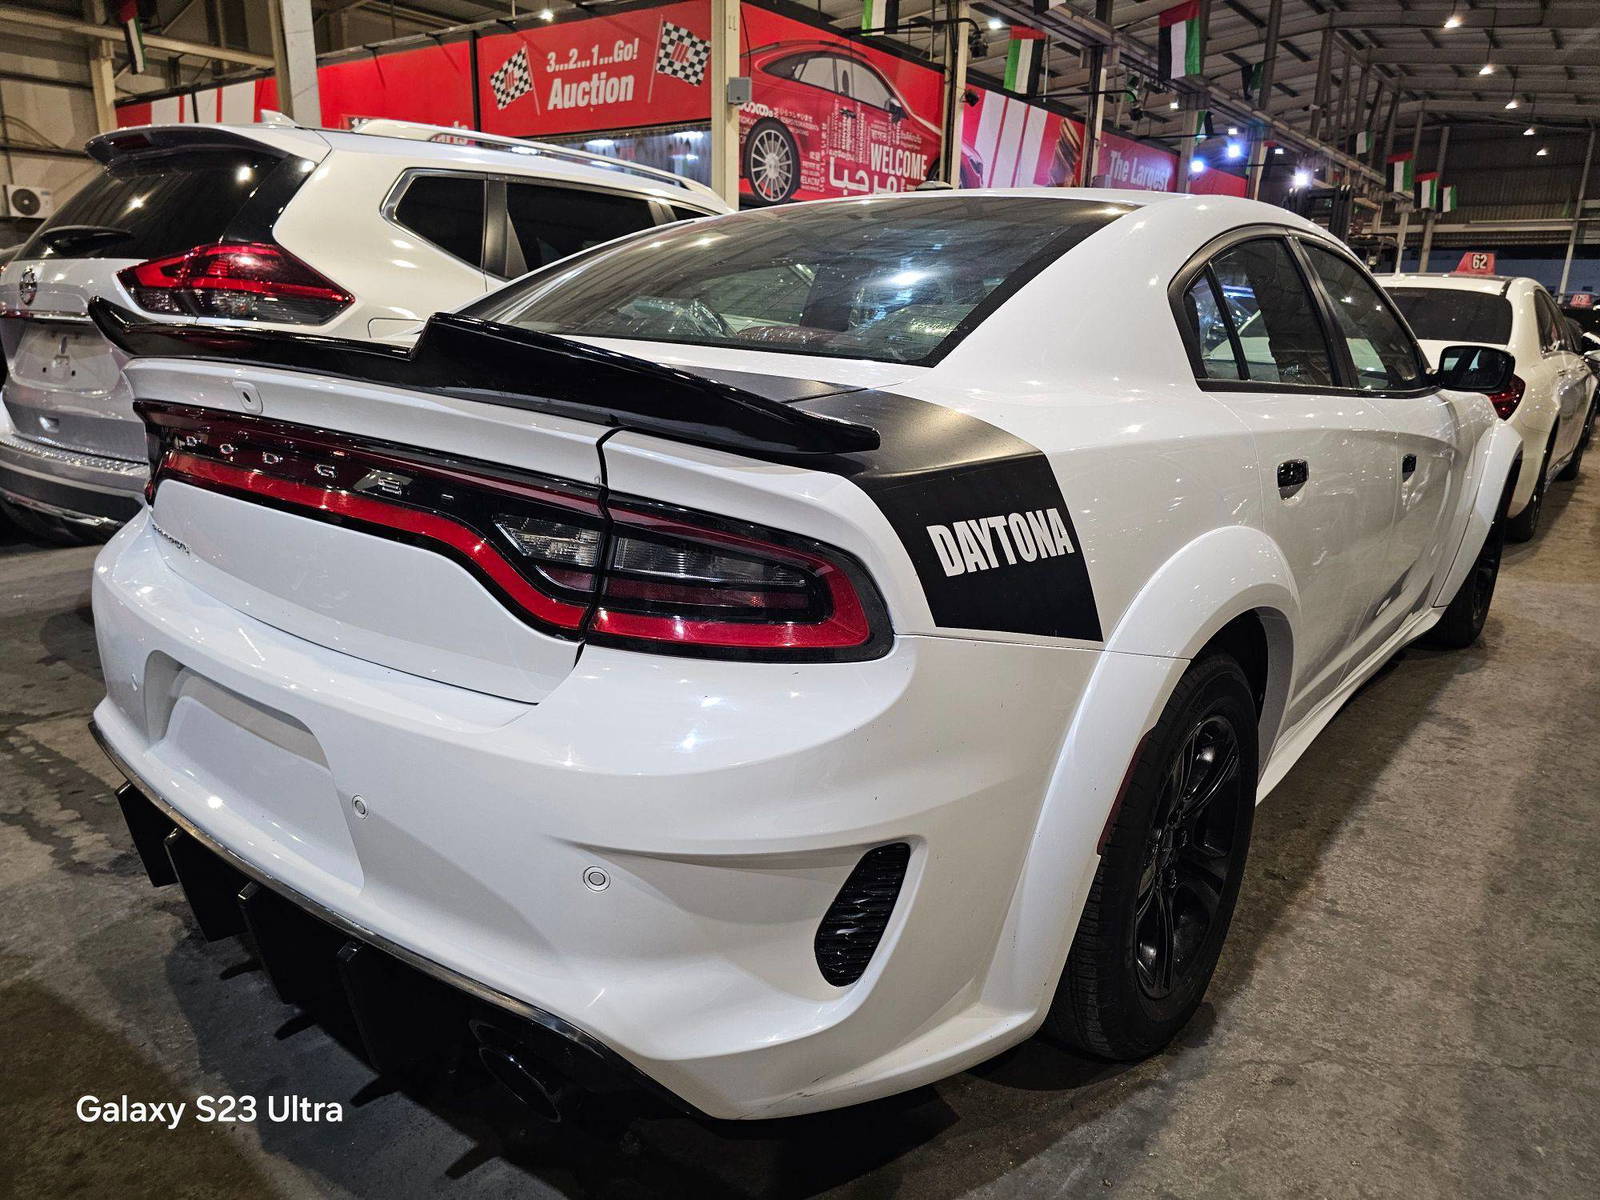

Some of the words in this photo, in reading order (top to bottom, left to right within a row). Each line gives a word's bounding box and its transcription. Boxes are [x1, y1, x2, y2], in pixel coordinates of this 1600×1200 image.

[547, 72, 635, 111] Auction
[870, 143, 928, 181] WELCOME
[1109, 150, 1130, 182] The
[1130, 157, 1170, 191] Largest
[1472, 253, 1488, 269] 62
[926, 507, 1075, 578] DAYTONA
